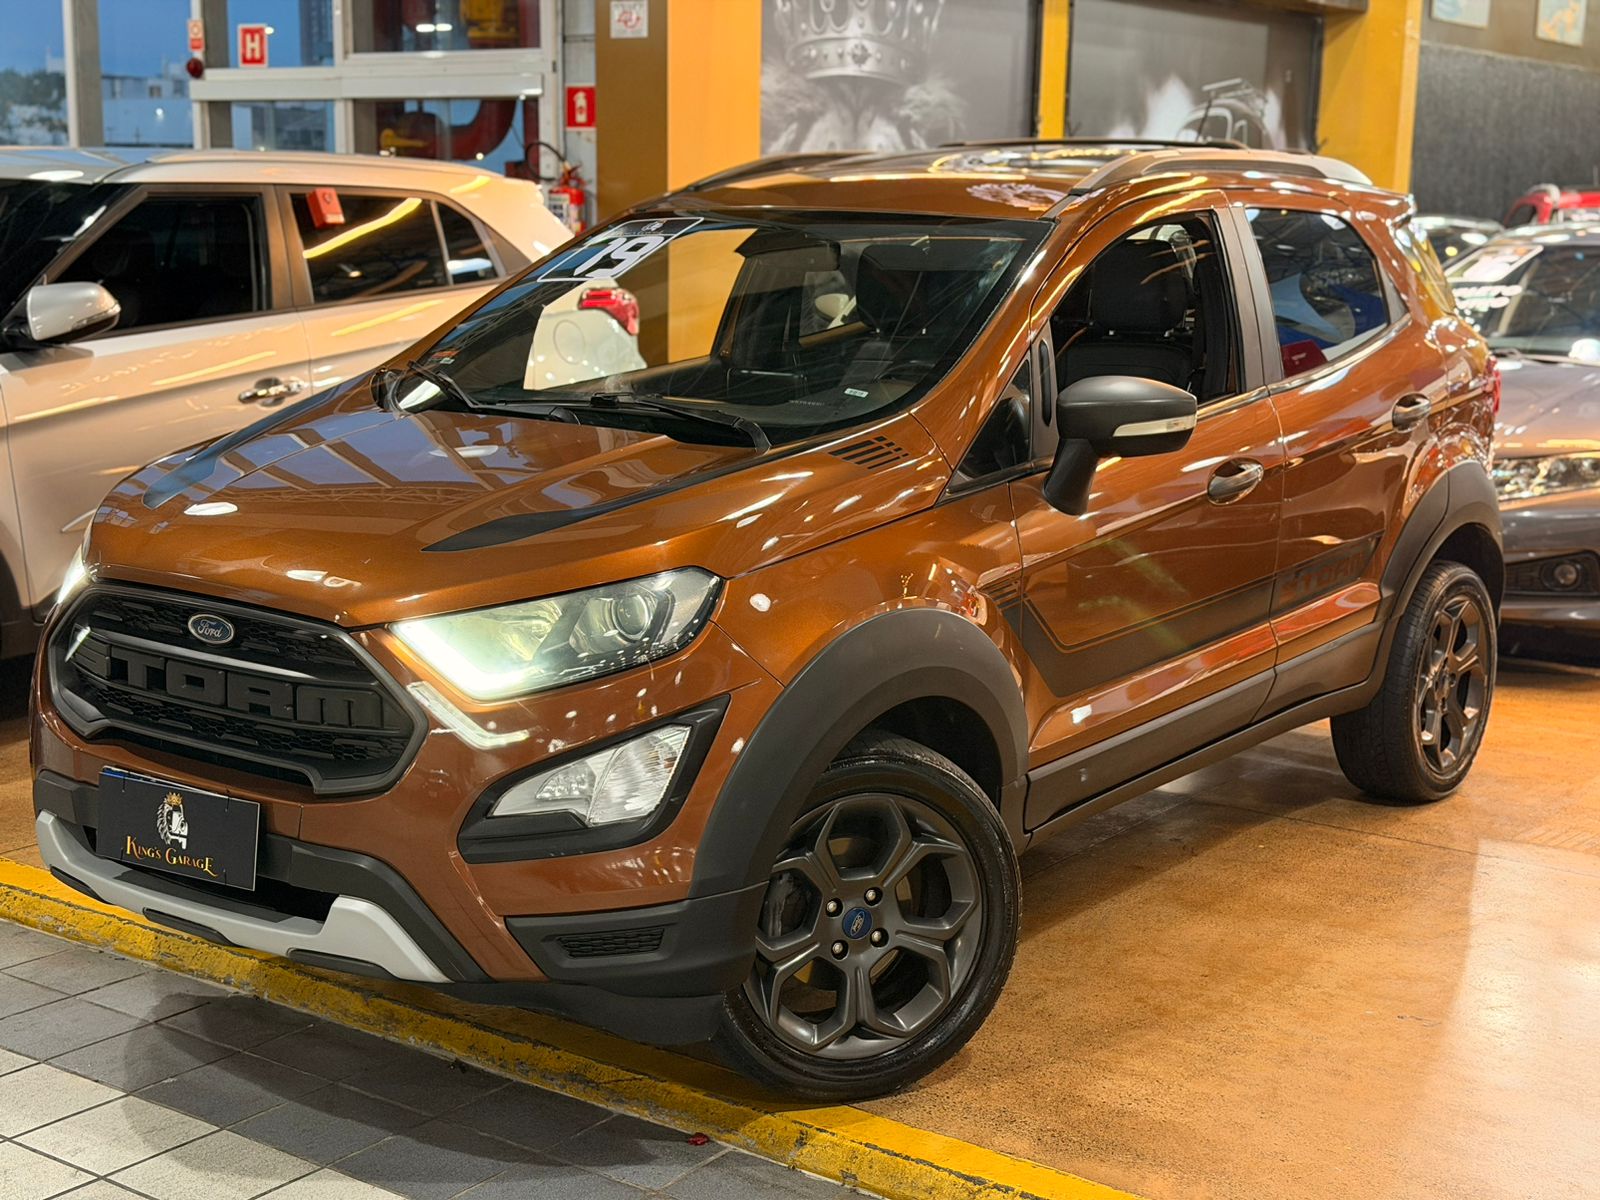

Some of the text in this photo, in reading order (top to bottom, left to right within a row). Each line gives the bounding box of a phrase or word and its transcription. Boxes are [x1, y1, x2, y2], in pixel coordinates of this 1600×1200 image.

[245, 33, 261, 60] H
[573, 236, 665, 279] 19
[197, 619, 223, 638] Ford
[71, 635, 384, 730] STORM
[165, 847, 219, 878] GARAGE
